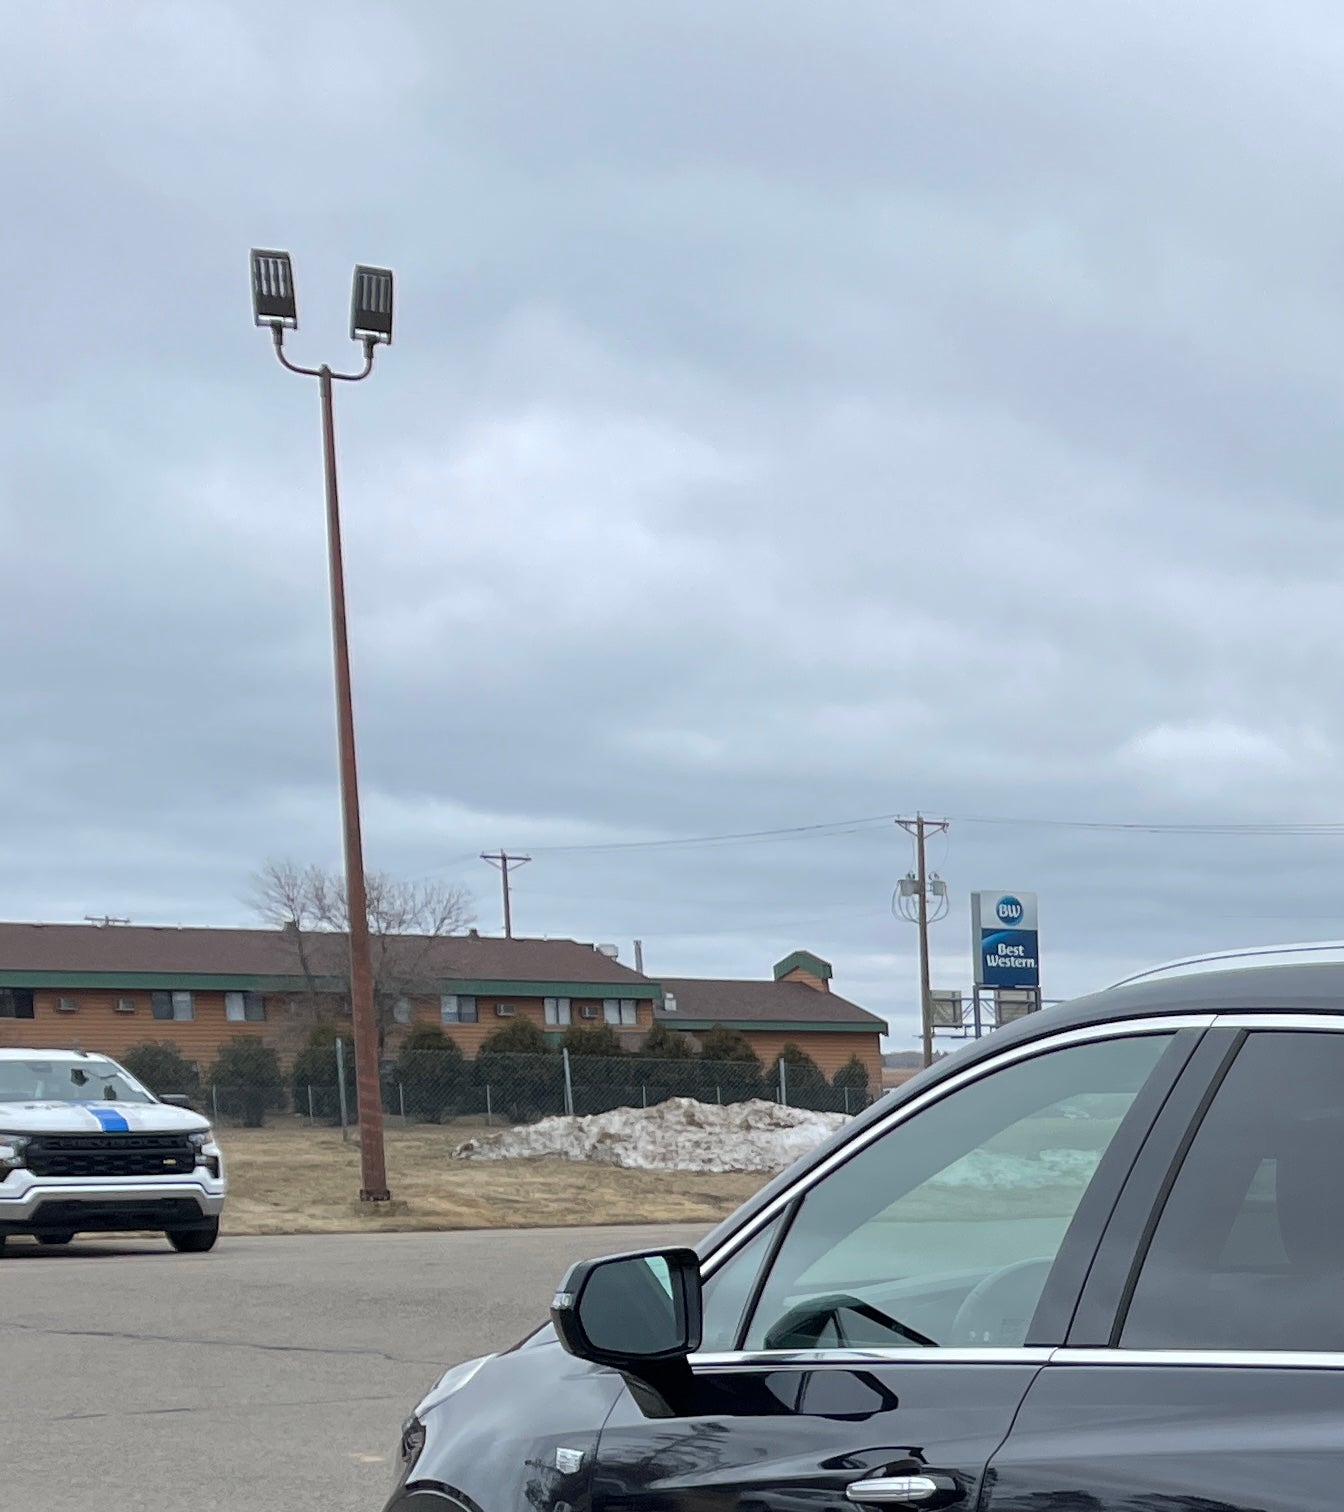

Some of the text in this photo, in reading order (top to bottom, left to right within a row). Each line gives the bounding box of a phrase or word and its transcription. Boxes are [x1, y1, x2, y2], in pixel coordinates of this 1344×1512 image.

[999, 903, 1021, 918] BW
[997, 943, 1024, 956] Best
[986, 954, 1035, 968] Western
